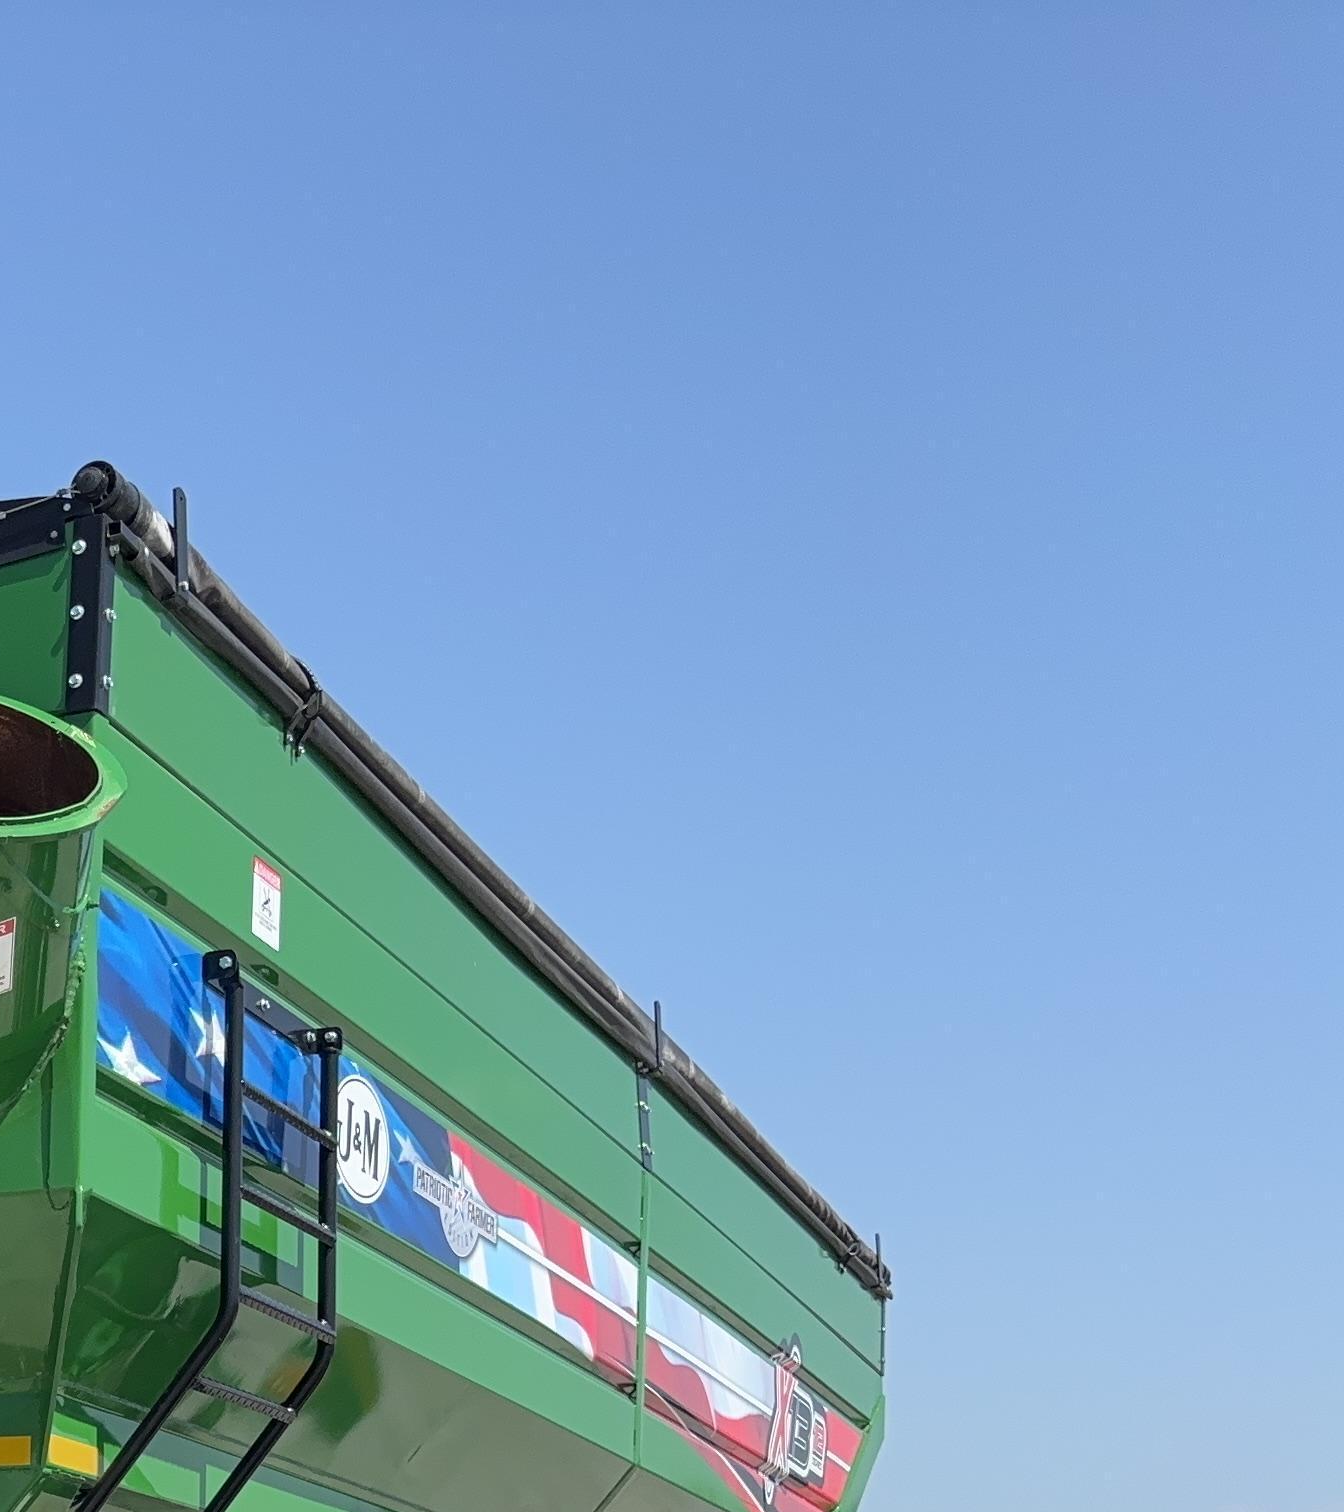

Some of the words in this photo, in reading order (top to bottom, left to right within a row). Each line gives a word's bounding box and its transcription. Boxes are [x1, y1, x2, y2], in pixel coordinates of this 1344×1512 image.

[337, 1097, 381, 1182] J&M
[415, 1166, 453, 1208] PATRIOTIC
[466, 1201, 496, 1236] FARMER
